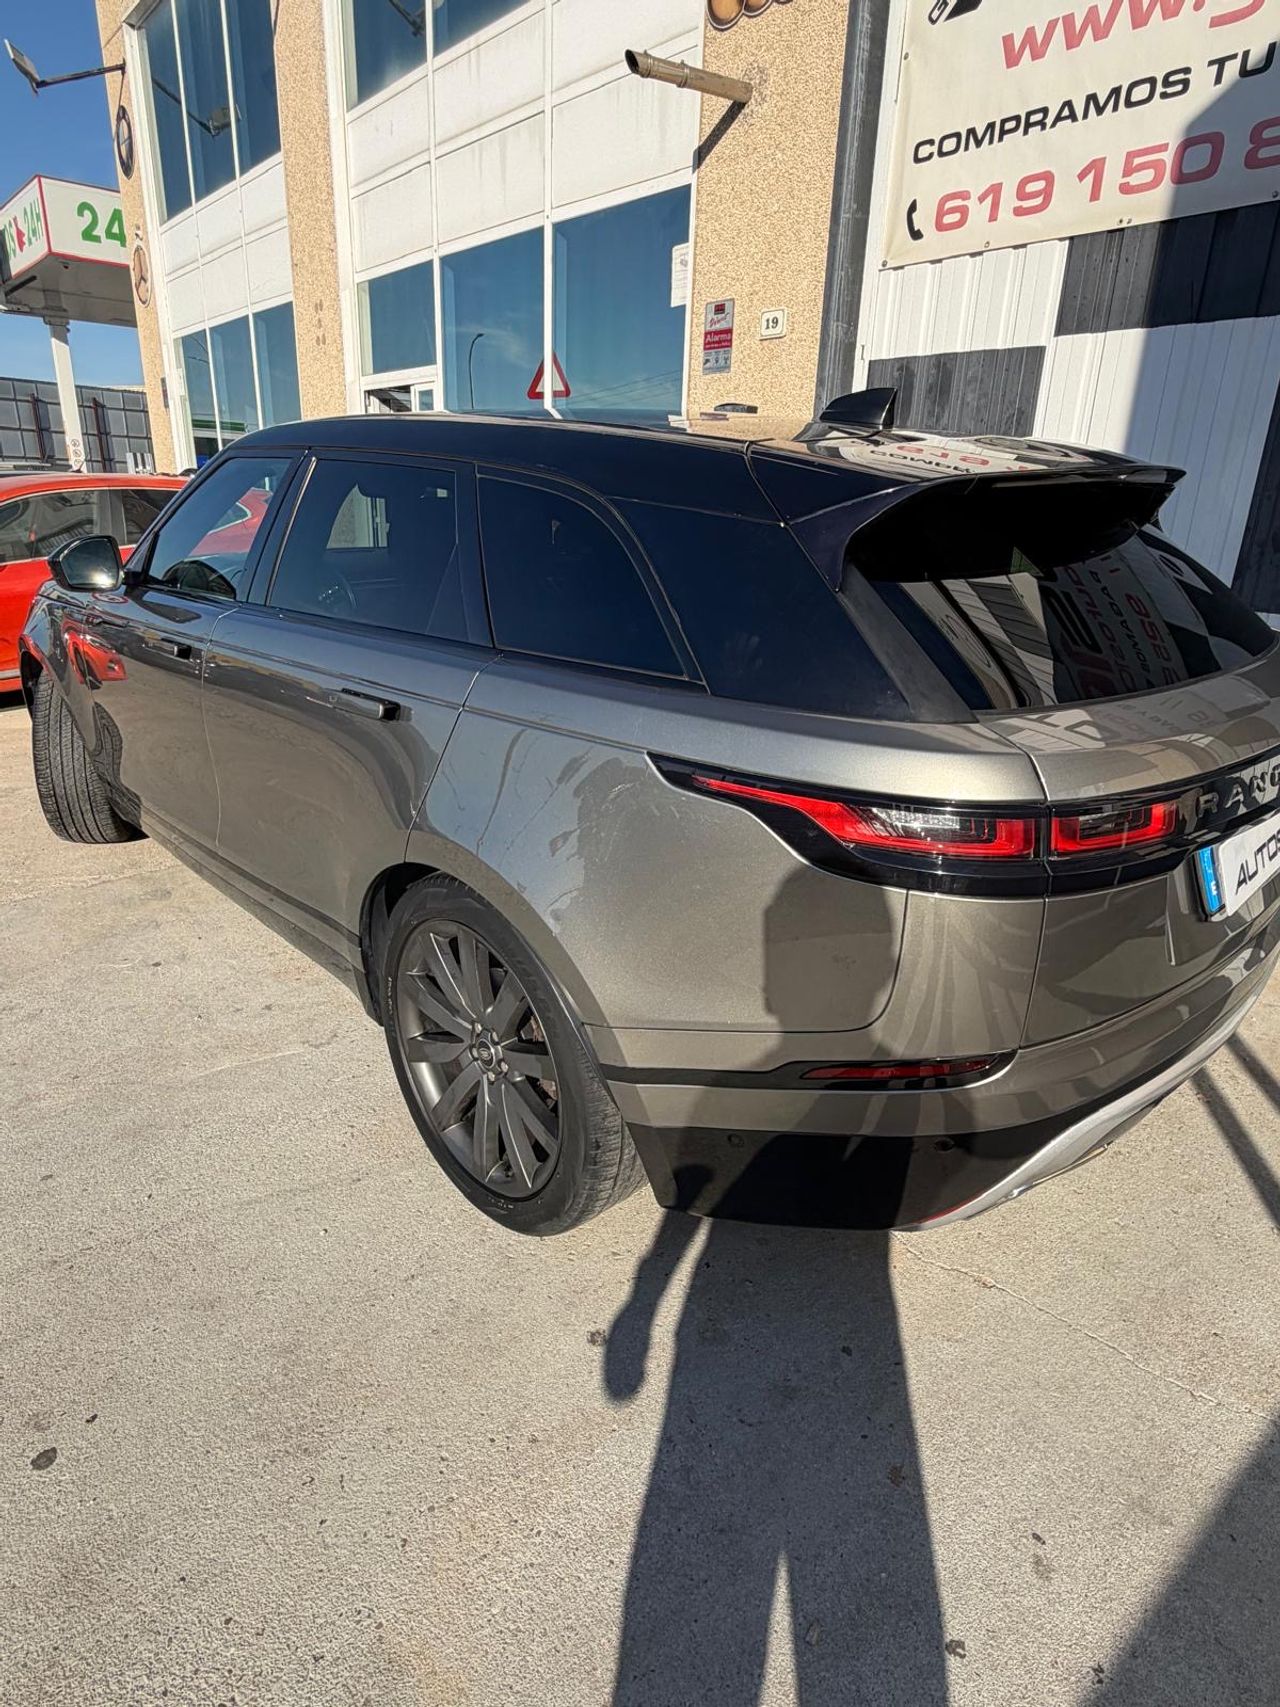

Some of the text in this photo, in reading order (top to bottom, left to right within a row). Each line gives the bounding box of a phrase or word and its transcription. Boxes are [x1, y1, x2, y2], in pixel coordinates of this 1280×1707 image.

[913, 41, 1278, 165] COMPRAMOS TU
[934, 170, 1056, 233] 619
[1077, 131, 1226, 203] 150
[77, 201, 127, 248] 24
[764, 316, 779, 330] 19
